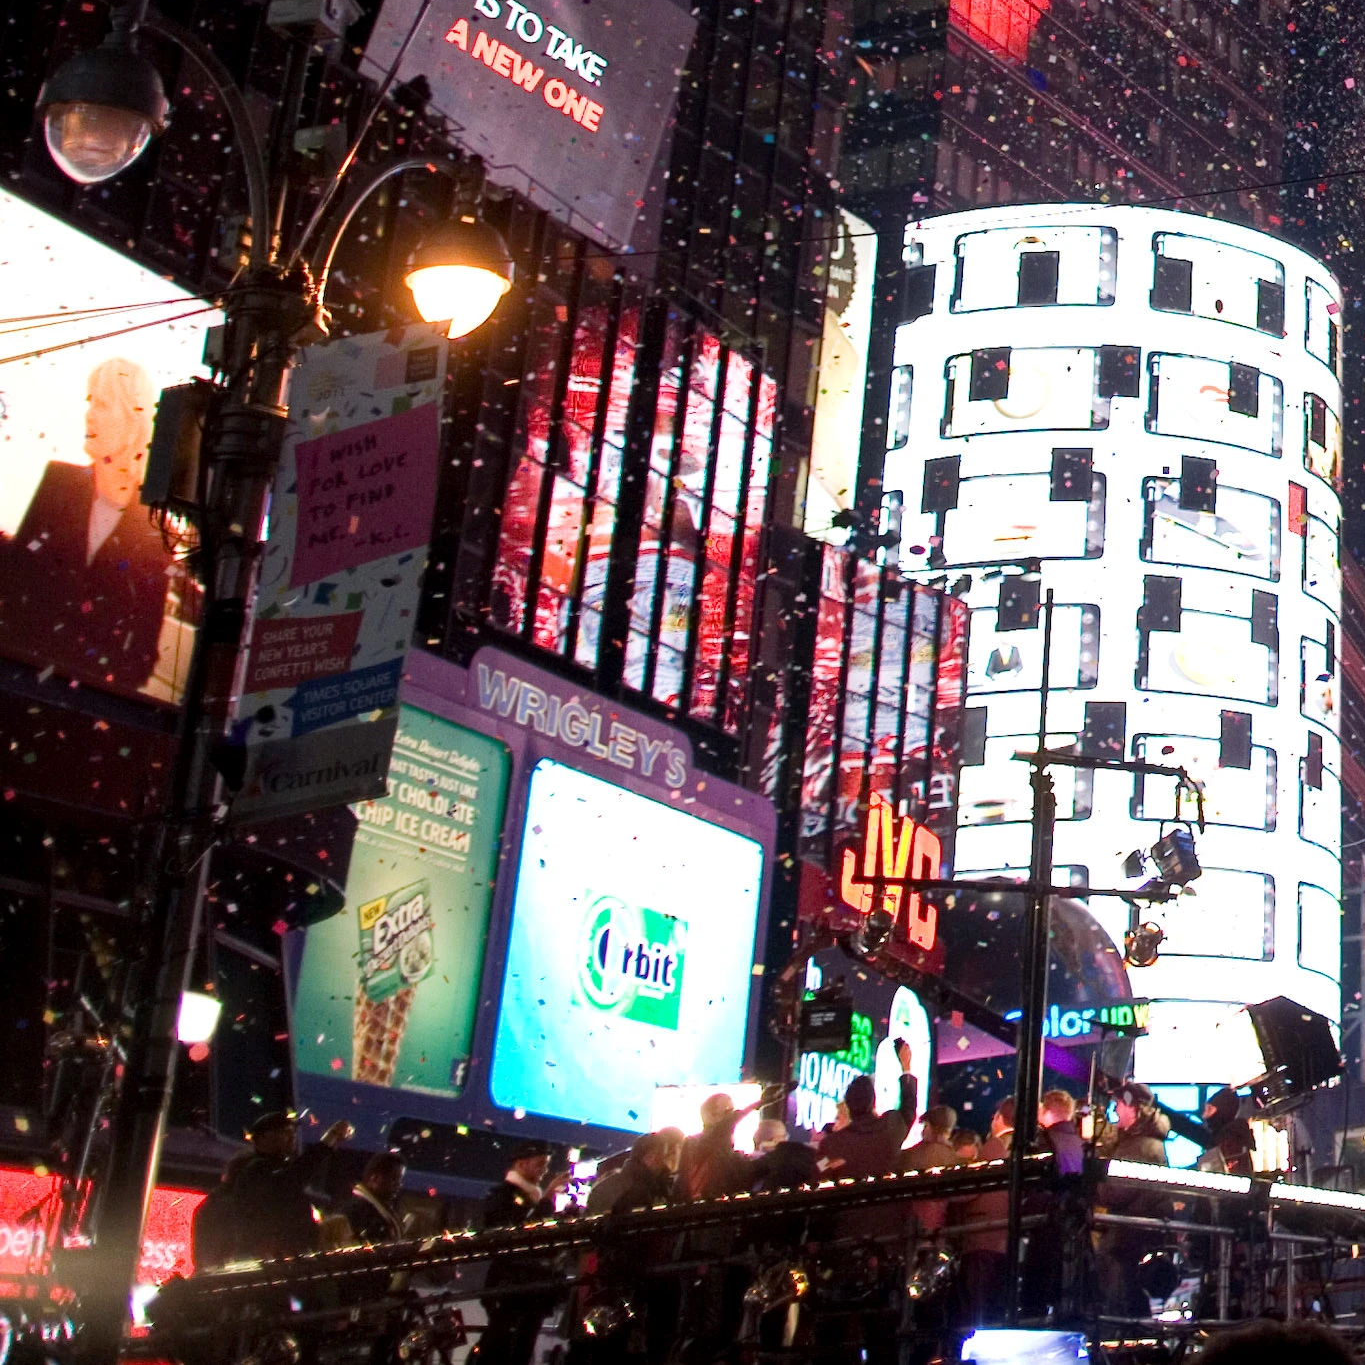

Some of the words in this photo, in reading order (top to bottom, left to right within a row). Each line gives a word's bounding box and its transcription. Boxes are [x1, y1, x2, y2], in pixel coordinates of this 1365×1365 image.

[443, 17, 469, 52] A
[470, 30, 545, 93] NEW
[543, 77, 605, 133] ONE
[478, 663, 688, 789] WRIGLEY'S
[395, 811, 420, 839] ICE
[420, 819, 471, 854] CREAM
[397, 782, 476, 826] CHOCOLATE
[840, 789, 943, 952] JVC
[583, 897, 674, 1008] Orbit
